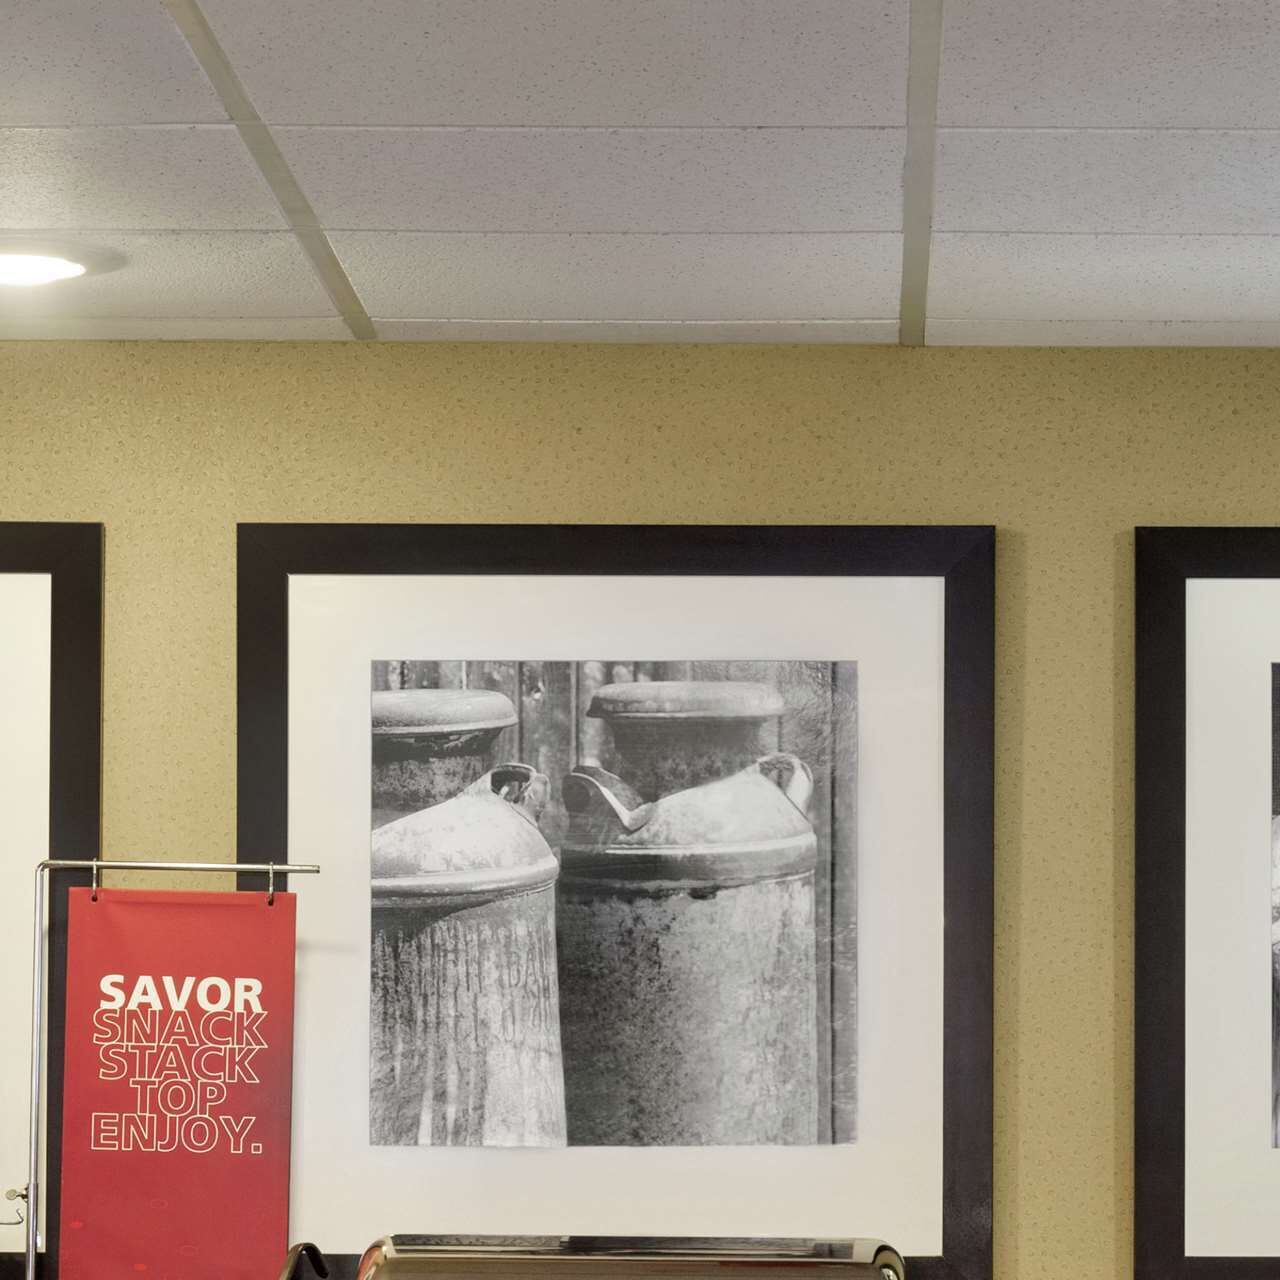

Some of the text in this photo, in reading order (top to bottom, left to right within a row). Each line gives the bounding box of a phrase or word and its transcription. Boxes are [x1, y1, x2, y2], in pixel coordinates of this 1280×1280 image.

[98, 974, 263, 1012] SAVOR
[92, 1007, 269, 1048] SNACK
[99, 1042, 260, 1083] STACK
[130, 1078, 227, 1117] TOP
[91, 1112, 263, 1154] ENJOY.
